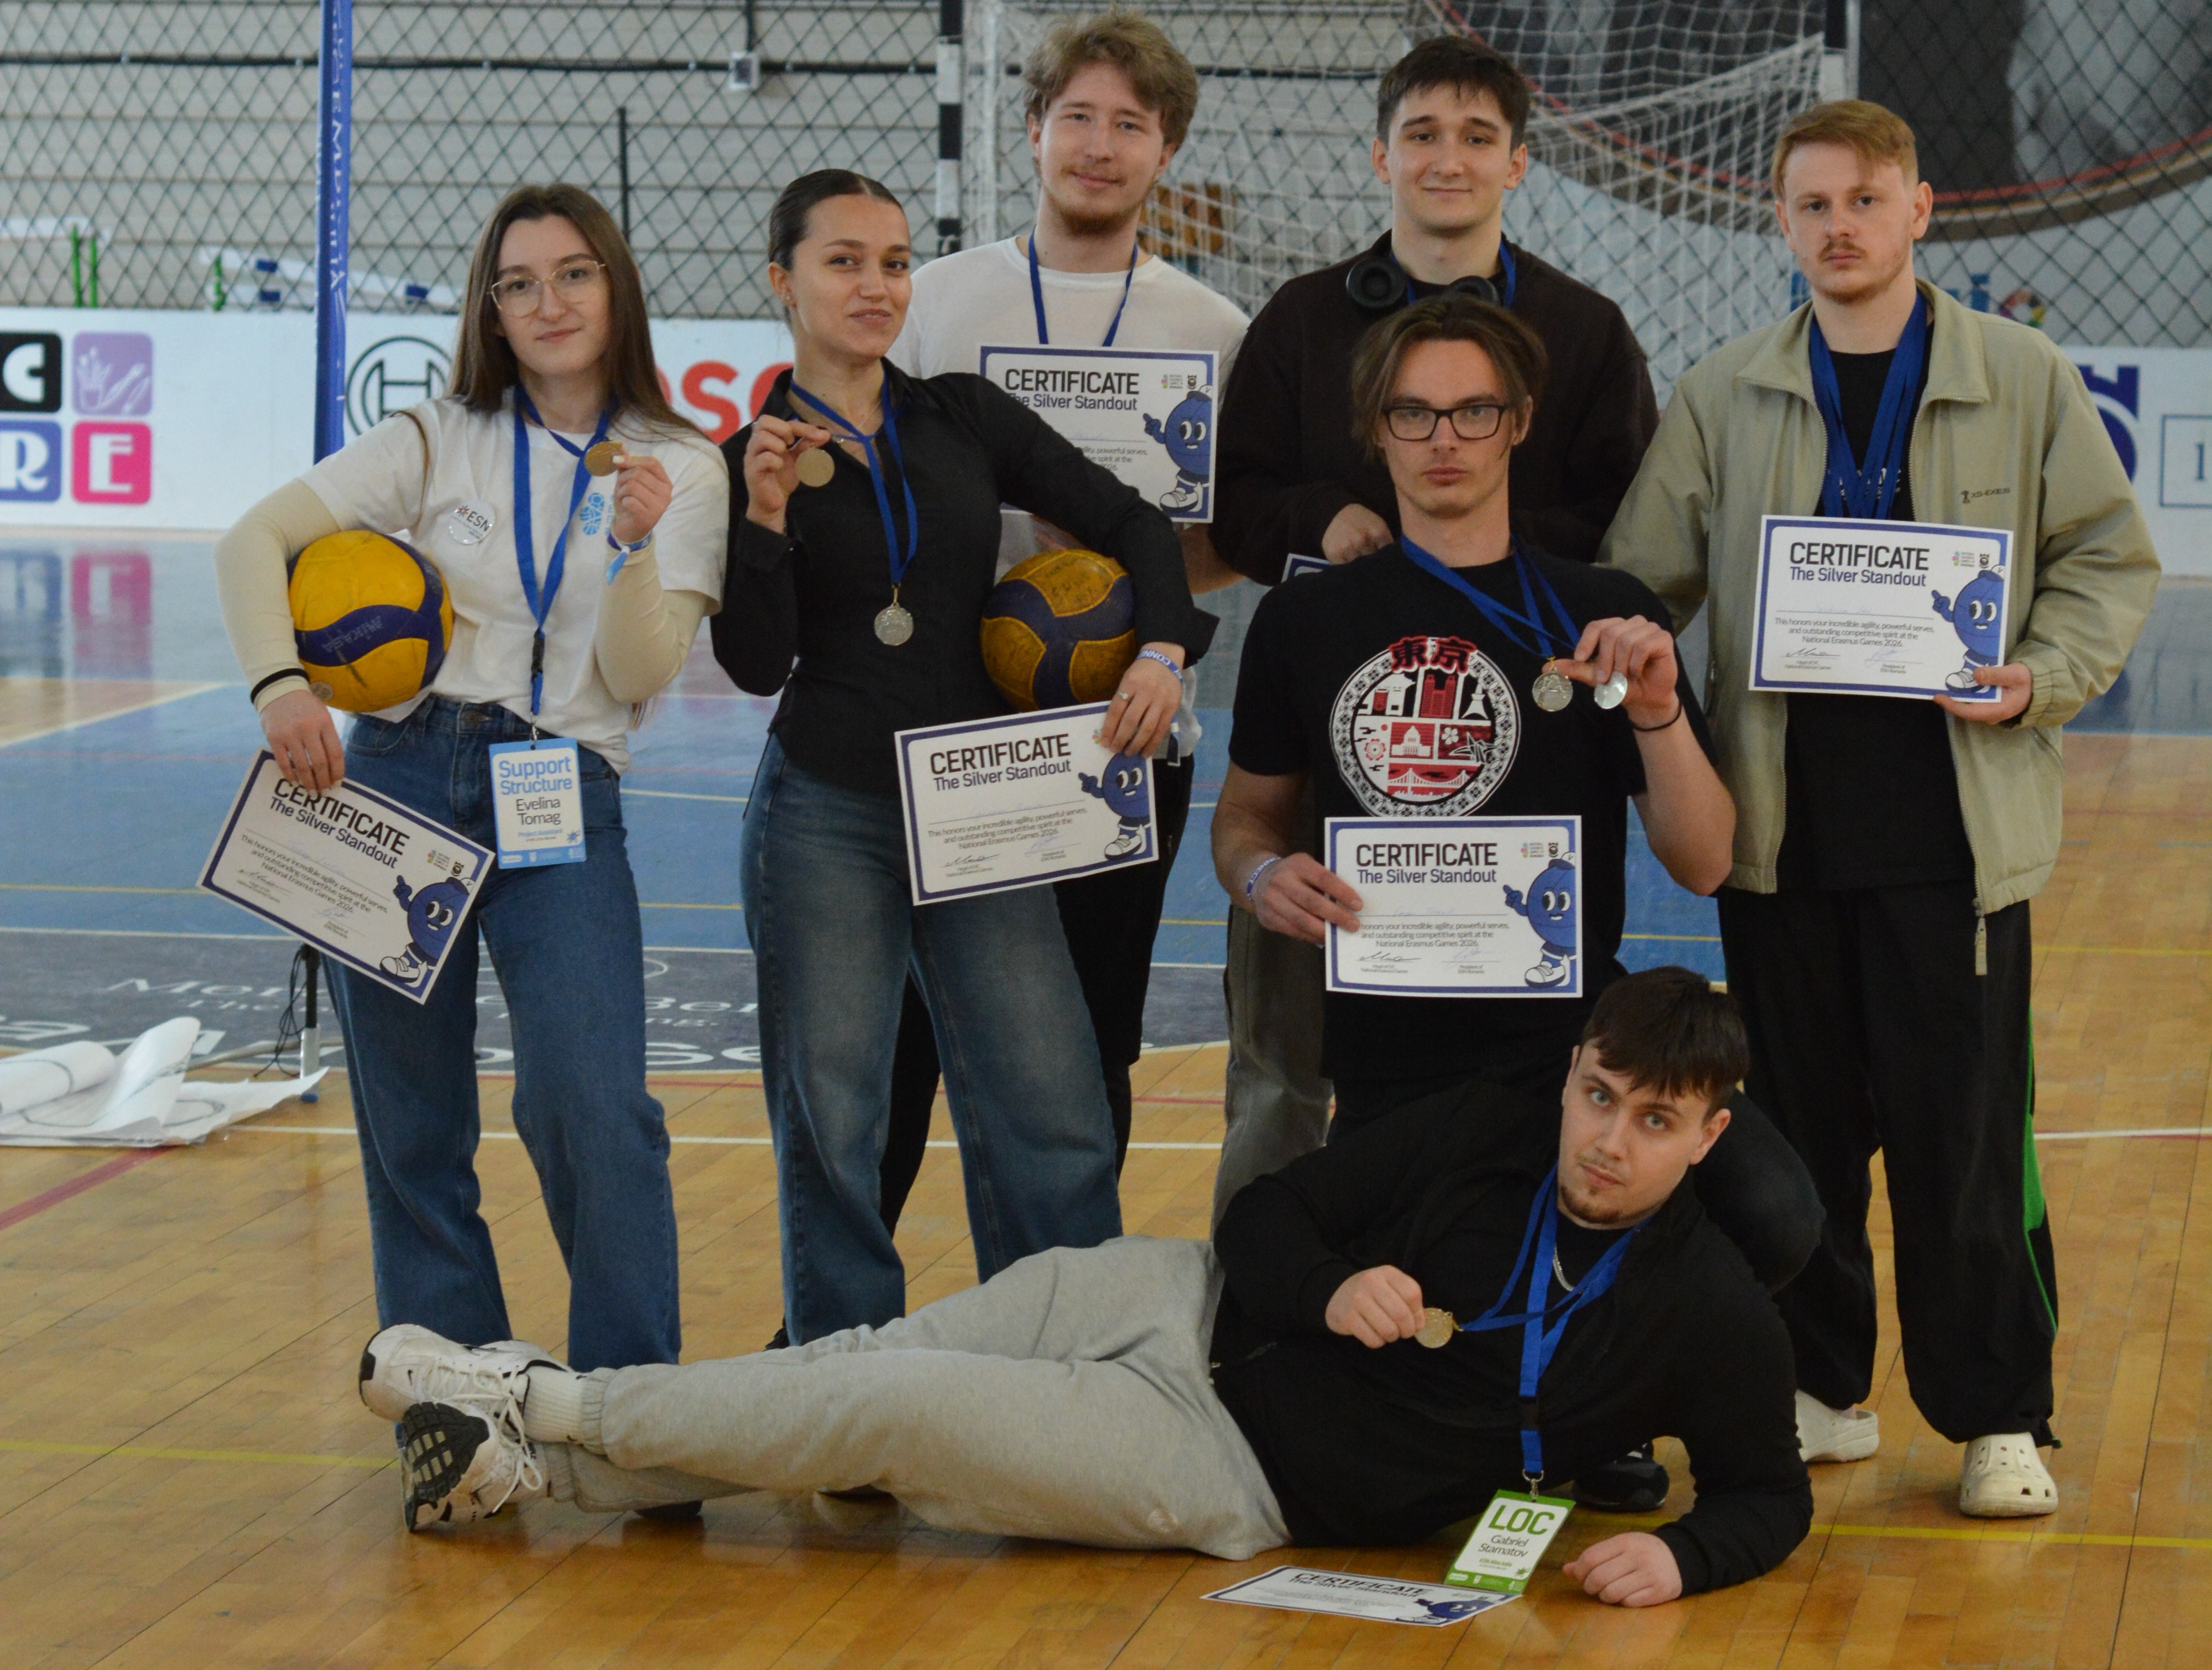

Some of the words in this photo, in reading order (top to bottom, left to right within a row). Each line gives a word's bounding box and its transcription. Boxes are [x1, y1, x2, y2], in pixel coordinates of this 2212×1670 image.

[1005, 369, 1139, 394] CERTIFICATE
[1034, 394, 1072, 408] Silver
[1075, 395, 1137, 410] Standout
[466, 511, 489, 531] ESN
[1789, 541, 1930, 571] CERTIFICATE
[1790, 566, 1814, 581] The
[1818, 567, 1858, 583] Silver
[1861, 570, 1927, 587] Standout
[1389, 636, 1477, 673] 東京
[931, 734, 1070, 774] CERTIFICATE
[499, 756, 571, 780] Support
[935, 775, 958, 790] The
[963, 769, 1002, 786] Silver
[1006, 759, 1070, 780] Standout
[500, 778, 572, 795] Structure
[516, 797, 561, 811] Evelina
[274, 776, 409, 854] CERTIFICATE
[518, 813, 561, 825] Tomag
[269, 797, 294, 817] The
[296, 810, 334, 836] Silver
[336, 830, 397, 867] Standout
[1357, 843, 1498, 866] CERTIFICATE
[1358, 869, 1383, 883] The
[1387, 869, 1427, 883] Silver
[1431, 868, 1496, 883] Standout
[1488, 1505, 1555, 1535] LOC
[1478, 1543, 1528, 1557] Stamatov
[1491, 1535, 1530, 1547] Gabriel
[1295, 1574, 1433, 1595] CERTIFICATE
[1358, 1587, 1419, 1597] Standout
